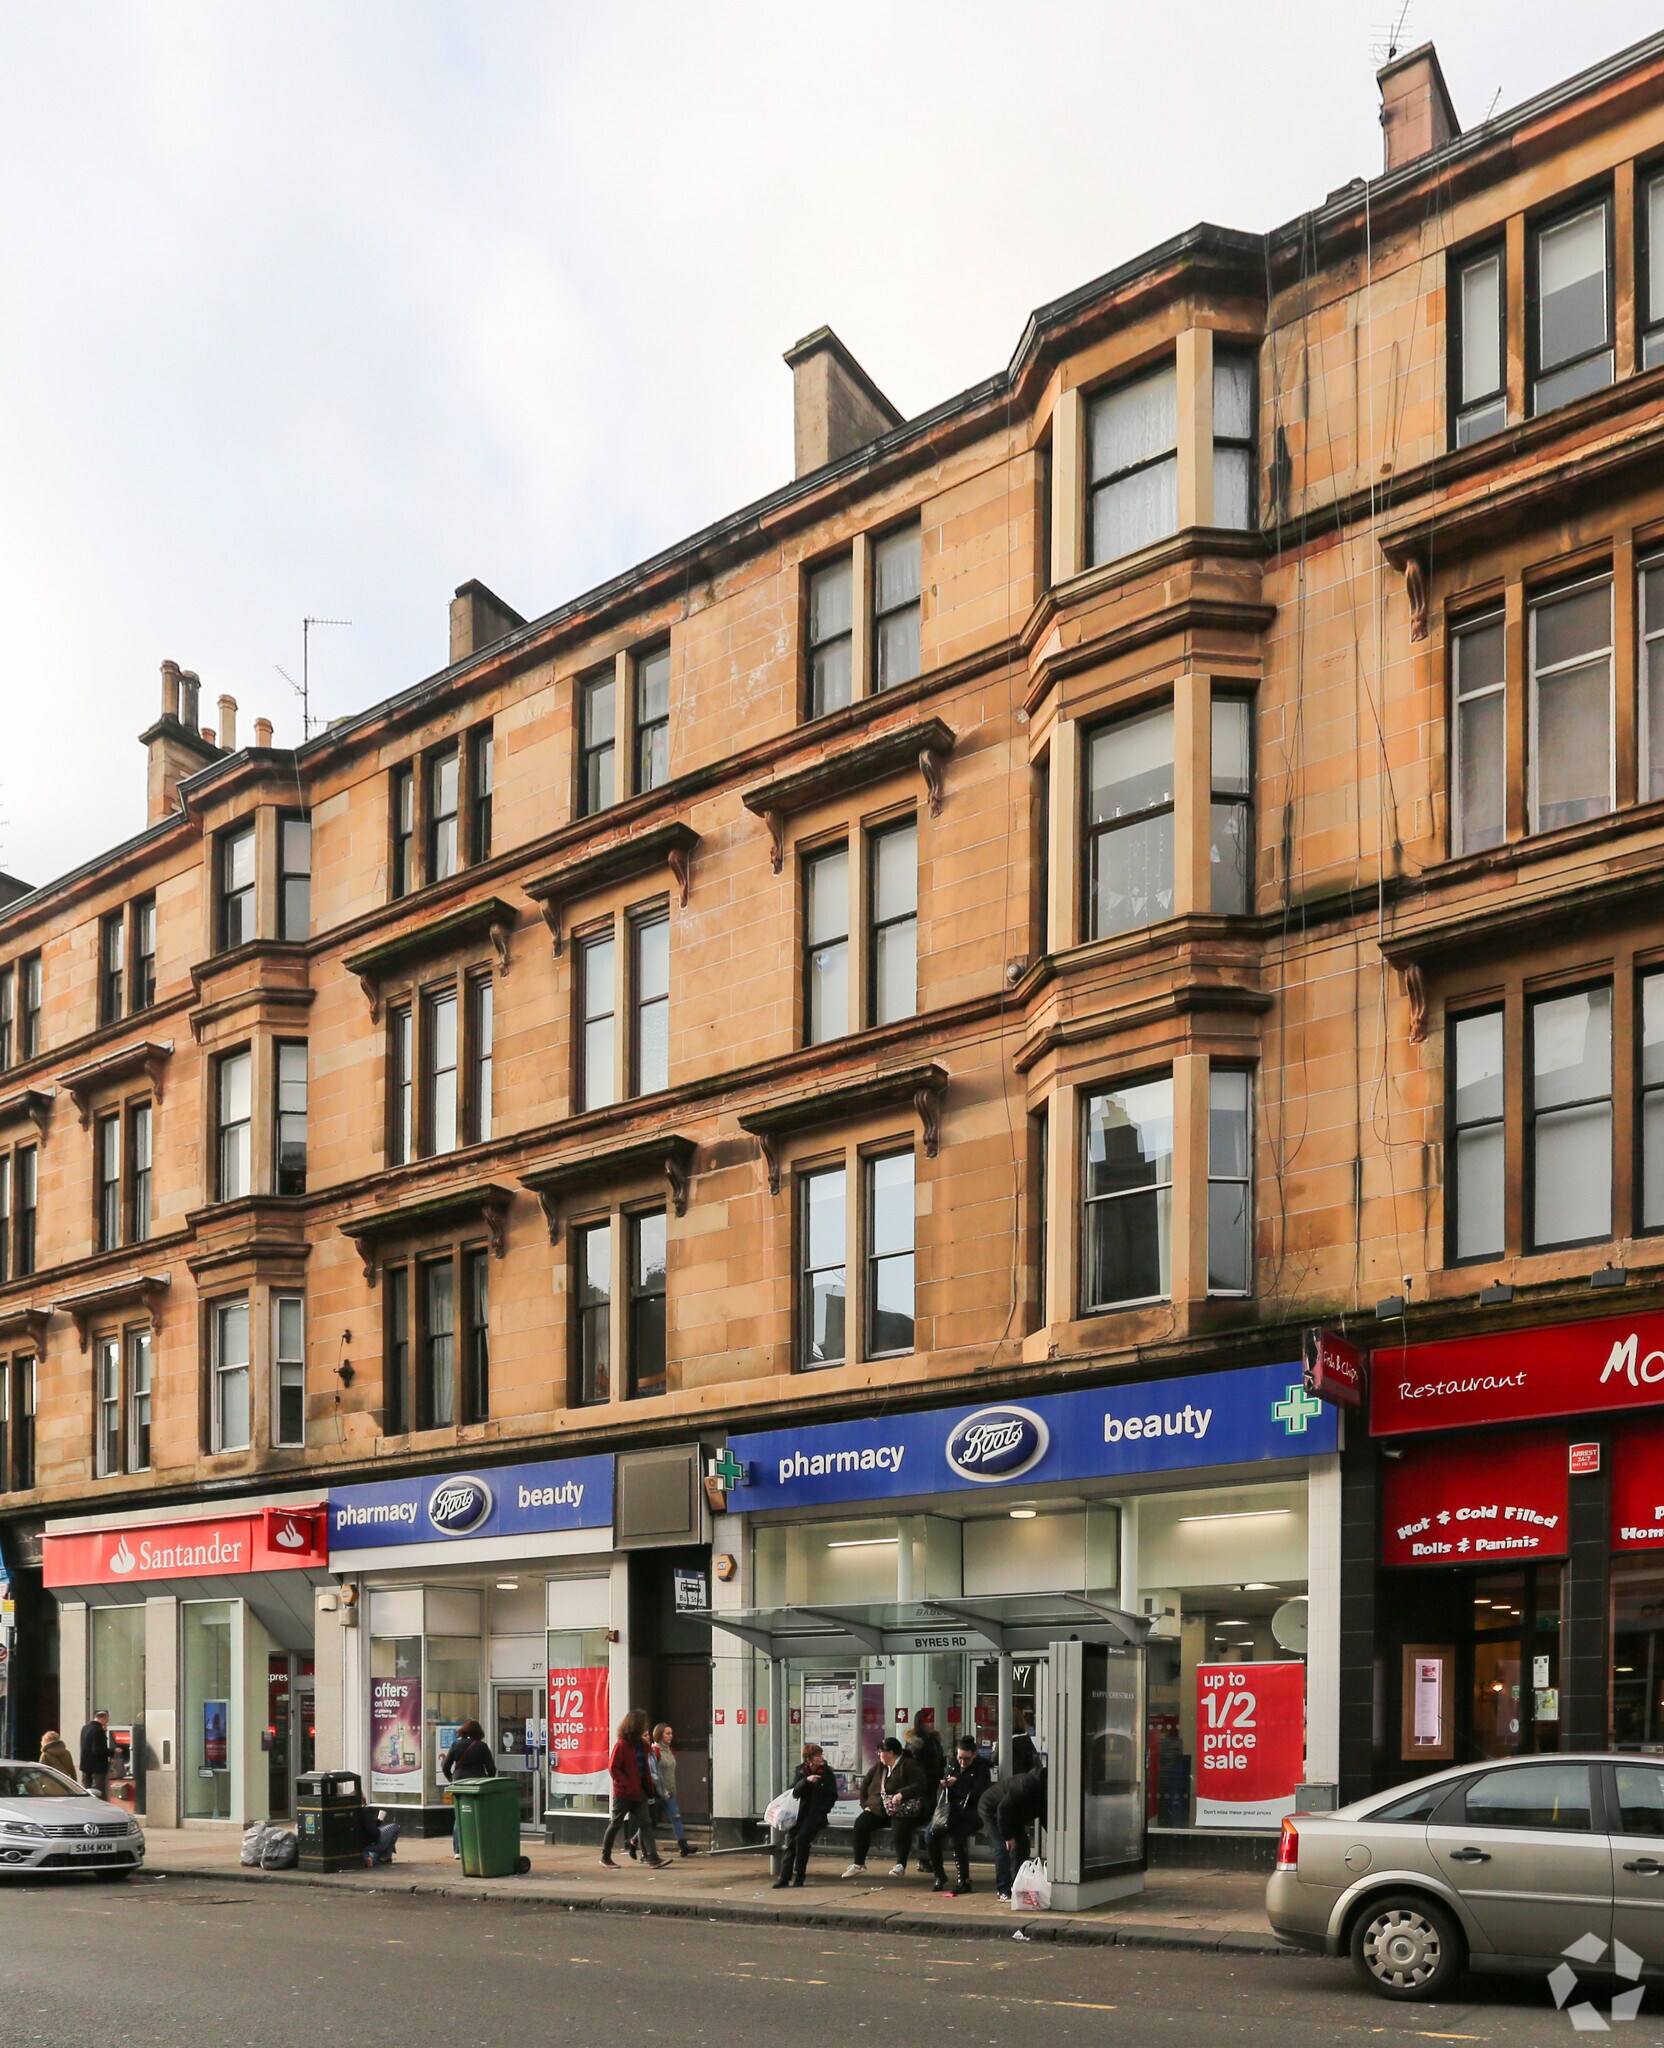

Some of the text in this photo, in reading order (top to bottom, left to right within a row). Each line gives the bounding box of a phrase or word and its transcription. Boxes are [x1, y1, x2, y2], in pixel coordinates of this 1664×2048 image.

[1341, 1362, 1359, 1384] Chips
[1398, 1371, 1527, 1399] Restaurant
[1104, 1404, 1212, 1443] beauty
[957, 1421, 1024, 1463] Boots
[779, 1445, 904, 1483] pharmacy
[432, 1487, 474, 1521] Boots
[518, 1480, 584, 1508] beauty
[336, 1502, 417, 1530] pharmacy
[1397, 1505, 1559, 1540] Hot & Cold Filled
[139, 1532, 242, 1570] Santander
[1412, 1536, 1540, 1556] Rolls & Paninis
[914, 1637, 967, 1647] BYRES RD
[374, 1683, 408, 1698] offers
[552, 1675, 577, 1688] up to
[1204, 1672, 1246, 1689] up to
[551, 1690, 584, 1718] 1/2
[1201, 1692, 1256, 1728] 1/2
[553, 1720, 584, 1736] price
[555, 1736, 579, 1750] sale
[1204, 1730, 1257, 1752] price
[1204, 1750, 1248, 1769] sale
[76, 1844, 94, 1852] SA14
